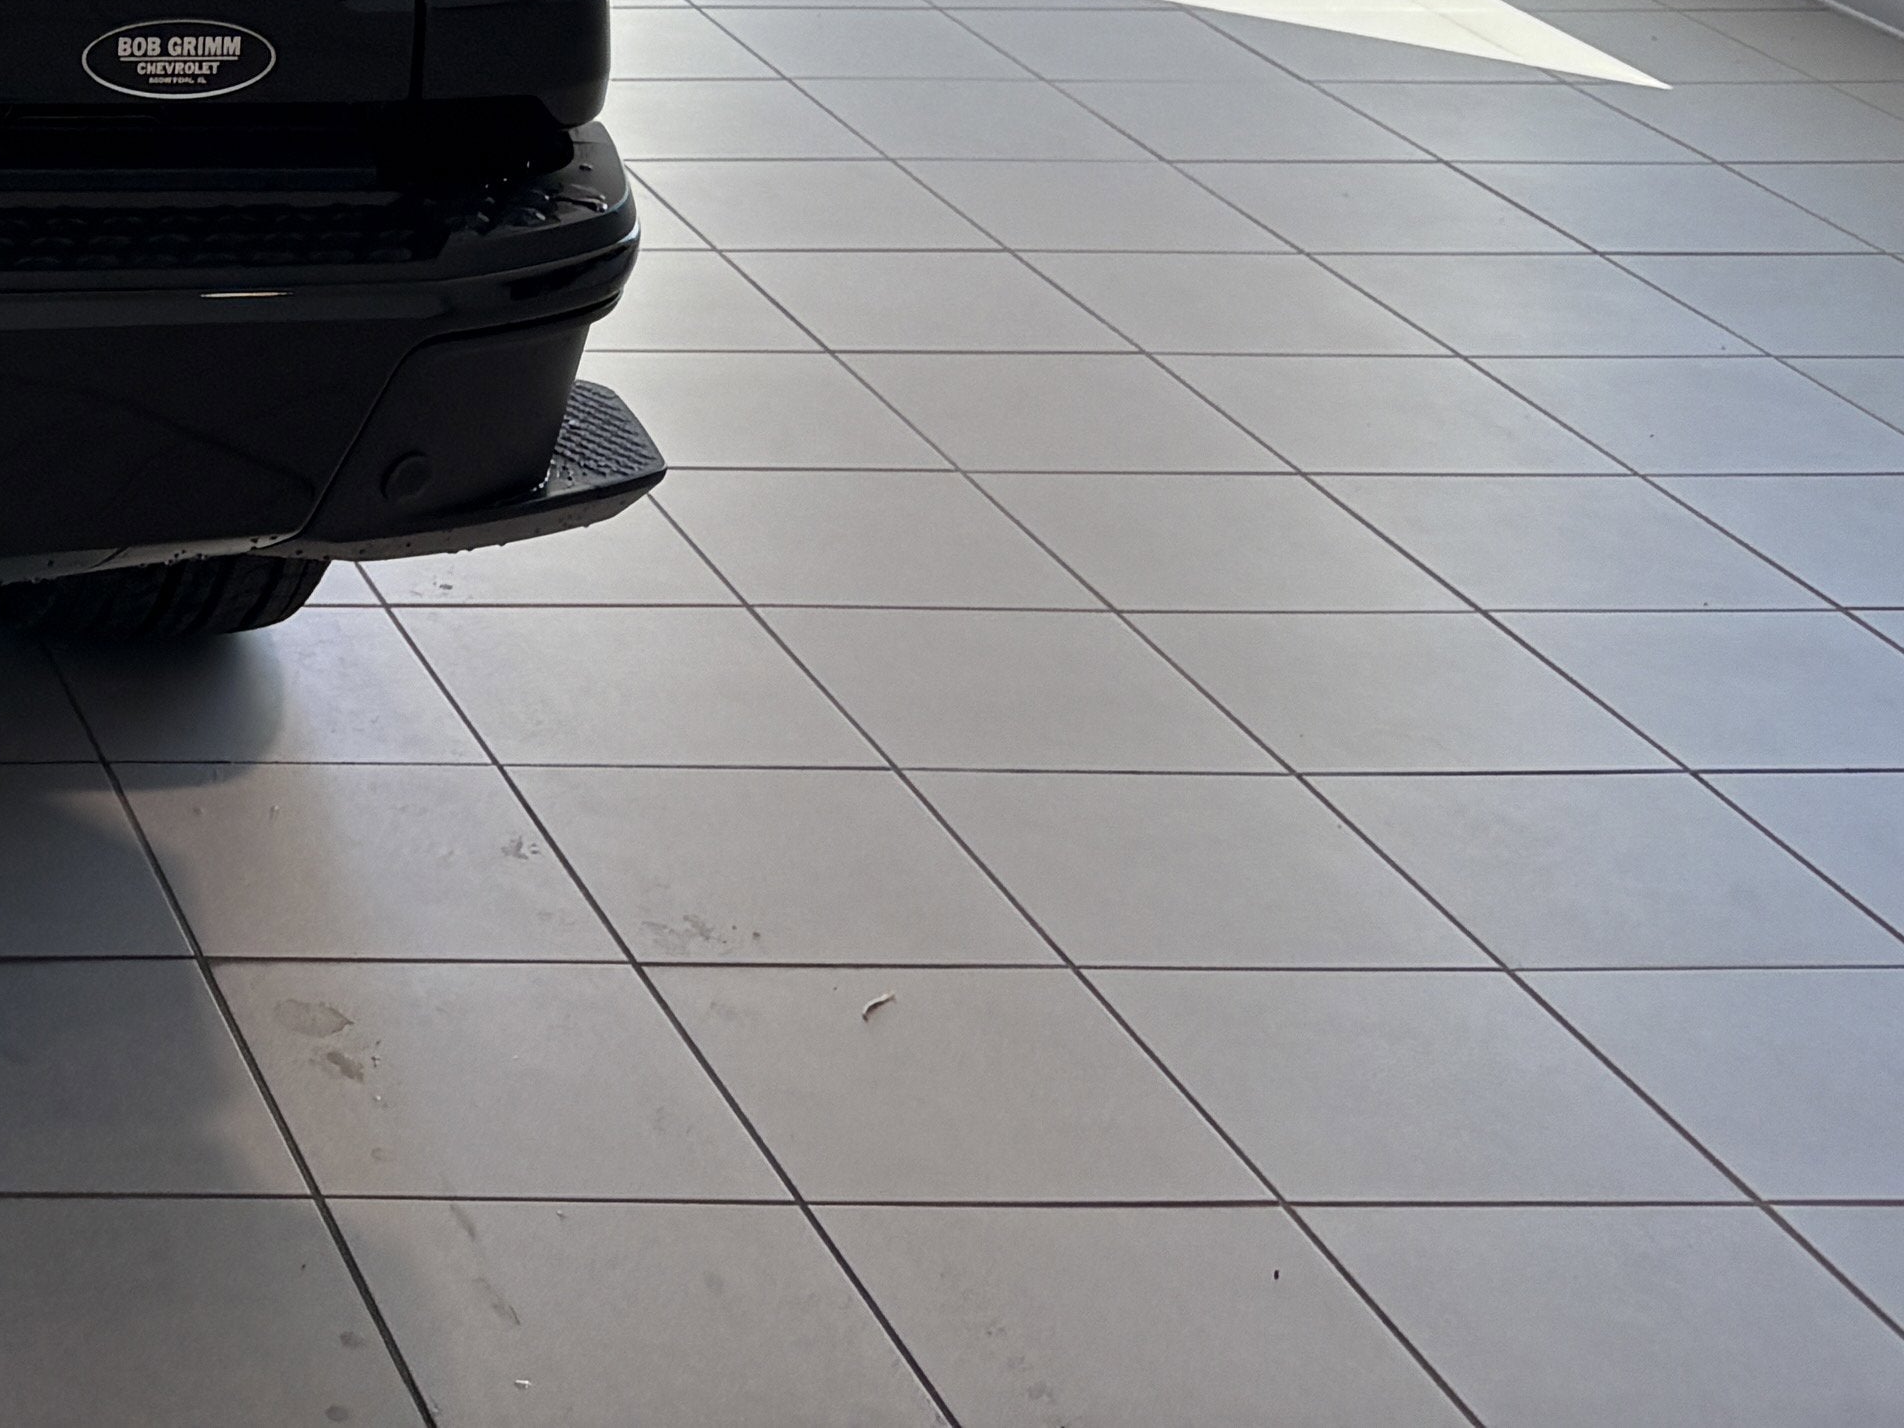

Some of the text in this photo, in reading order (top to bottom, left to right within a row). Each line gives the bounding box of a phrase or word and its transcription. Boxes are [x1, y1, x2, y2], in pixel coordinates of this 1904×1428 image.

[118, 35, 242, 56] BOB GRIMM
[136, 61, 221, 75] CHEVROLET
